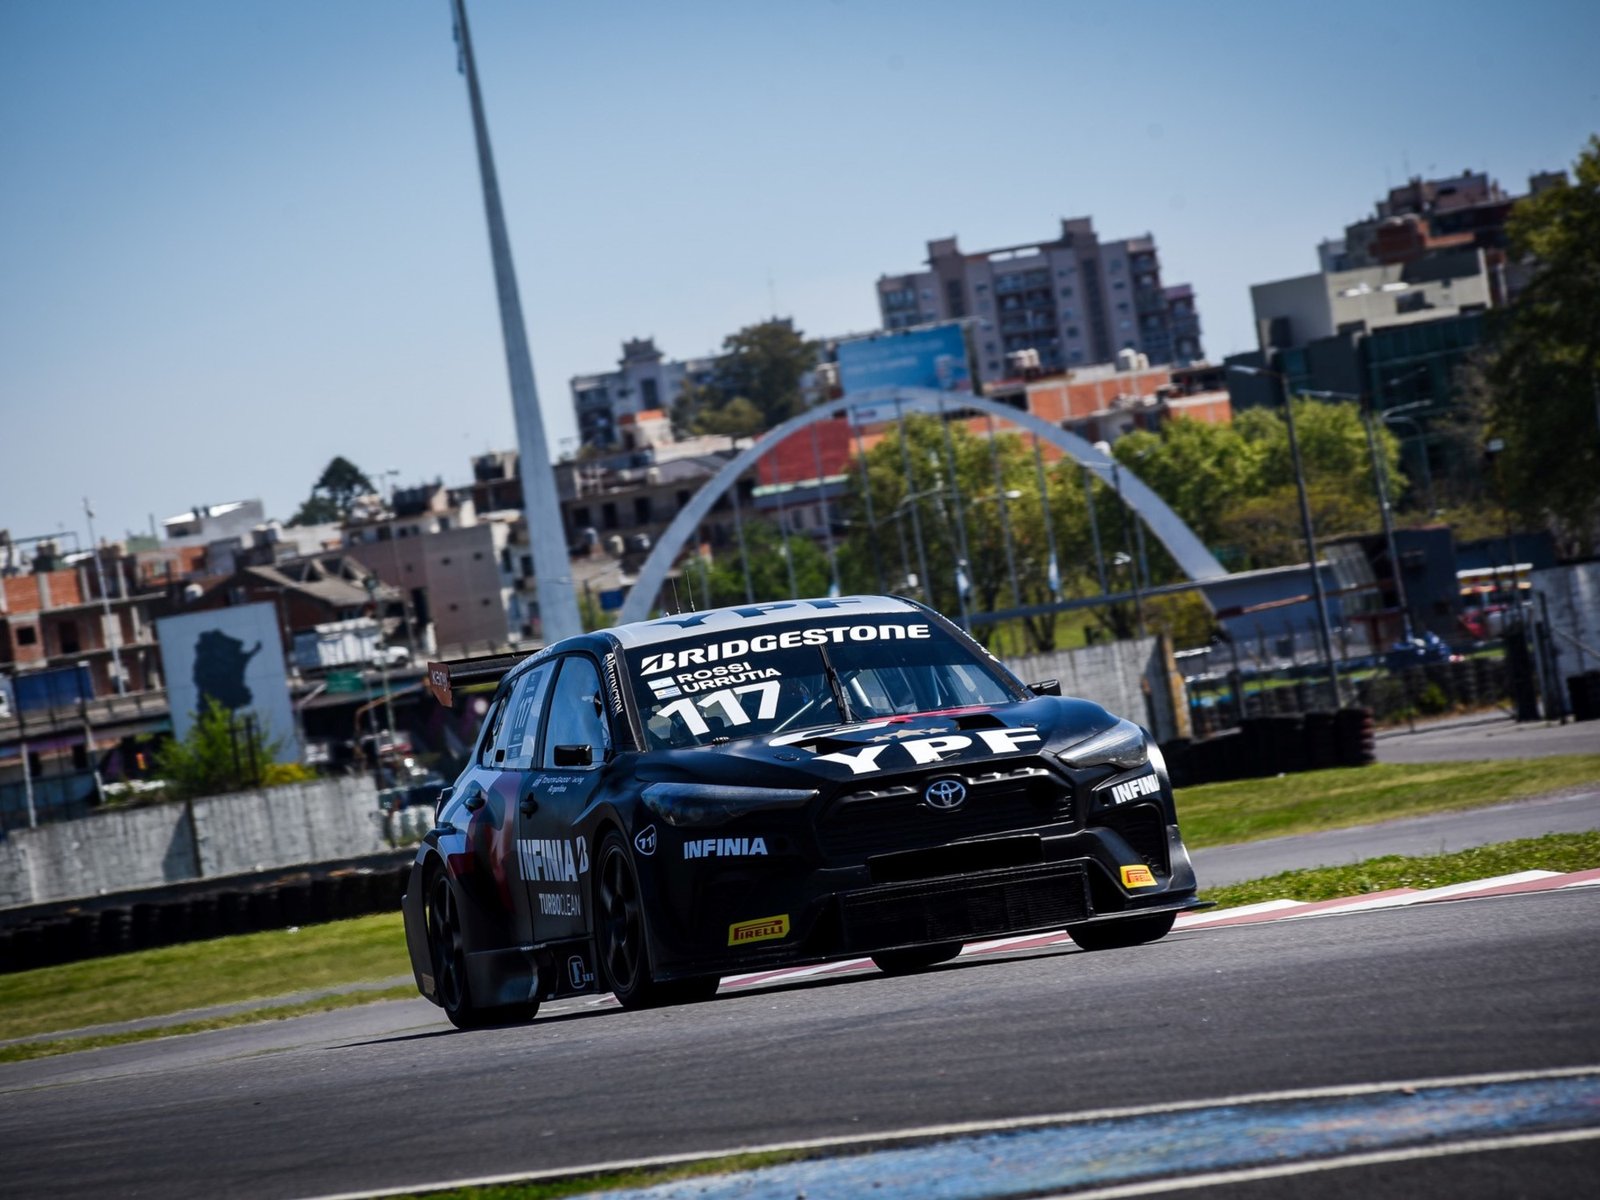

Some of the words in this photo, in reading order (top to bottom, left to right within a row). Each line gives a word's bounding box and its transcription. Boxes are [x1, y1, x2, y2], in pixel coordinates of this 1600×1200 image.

[640, 624, 931, 676] BRIDGESTONE
[676, 661, 752, 684] ROSSI
[682, 667, 782, 693] URRUTIA
[656, 679, 781, 736] 117
[811, 727, 1042, 775] YPF
[516, 839, 579, 882] INFINIA
[683, 837, 769, 860] INFINIA
[538, 893, 581, 916] TURBOCLEAN
[733, 919, 784, 941] PIRELLI
